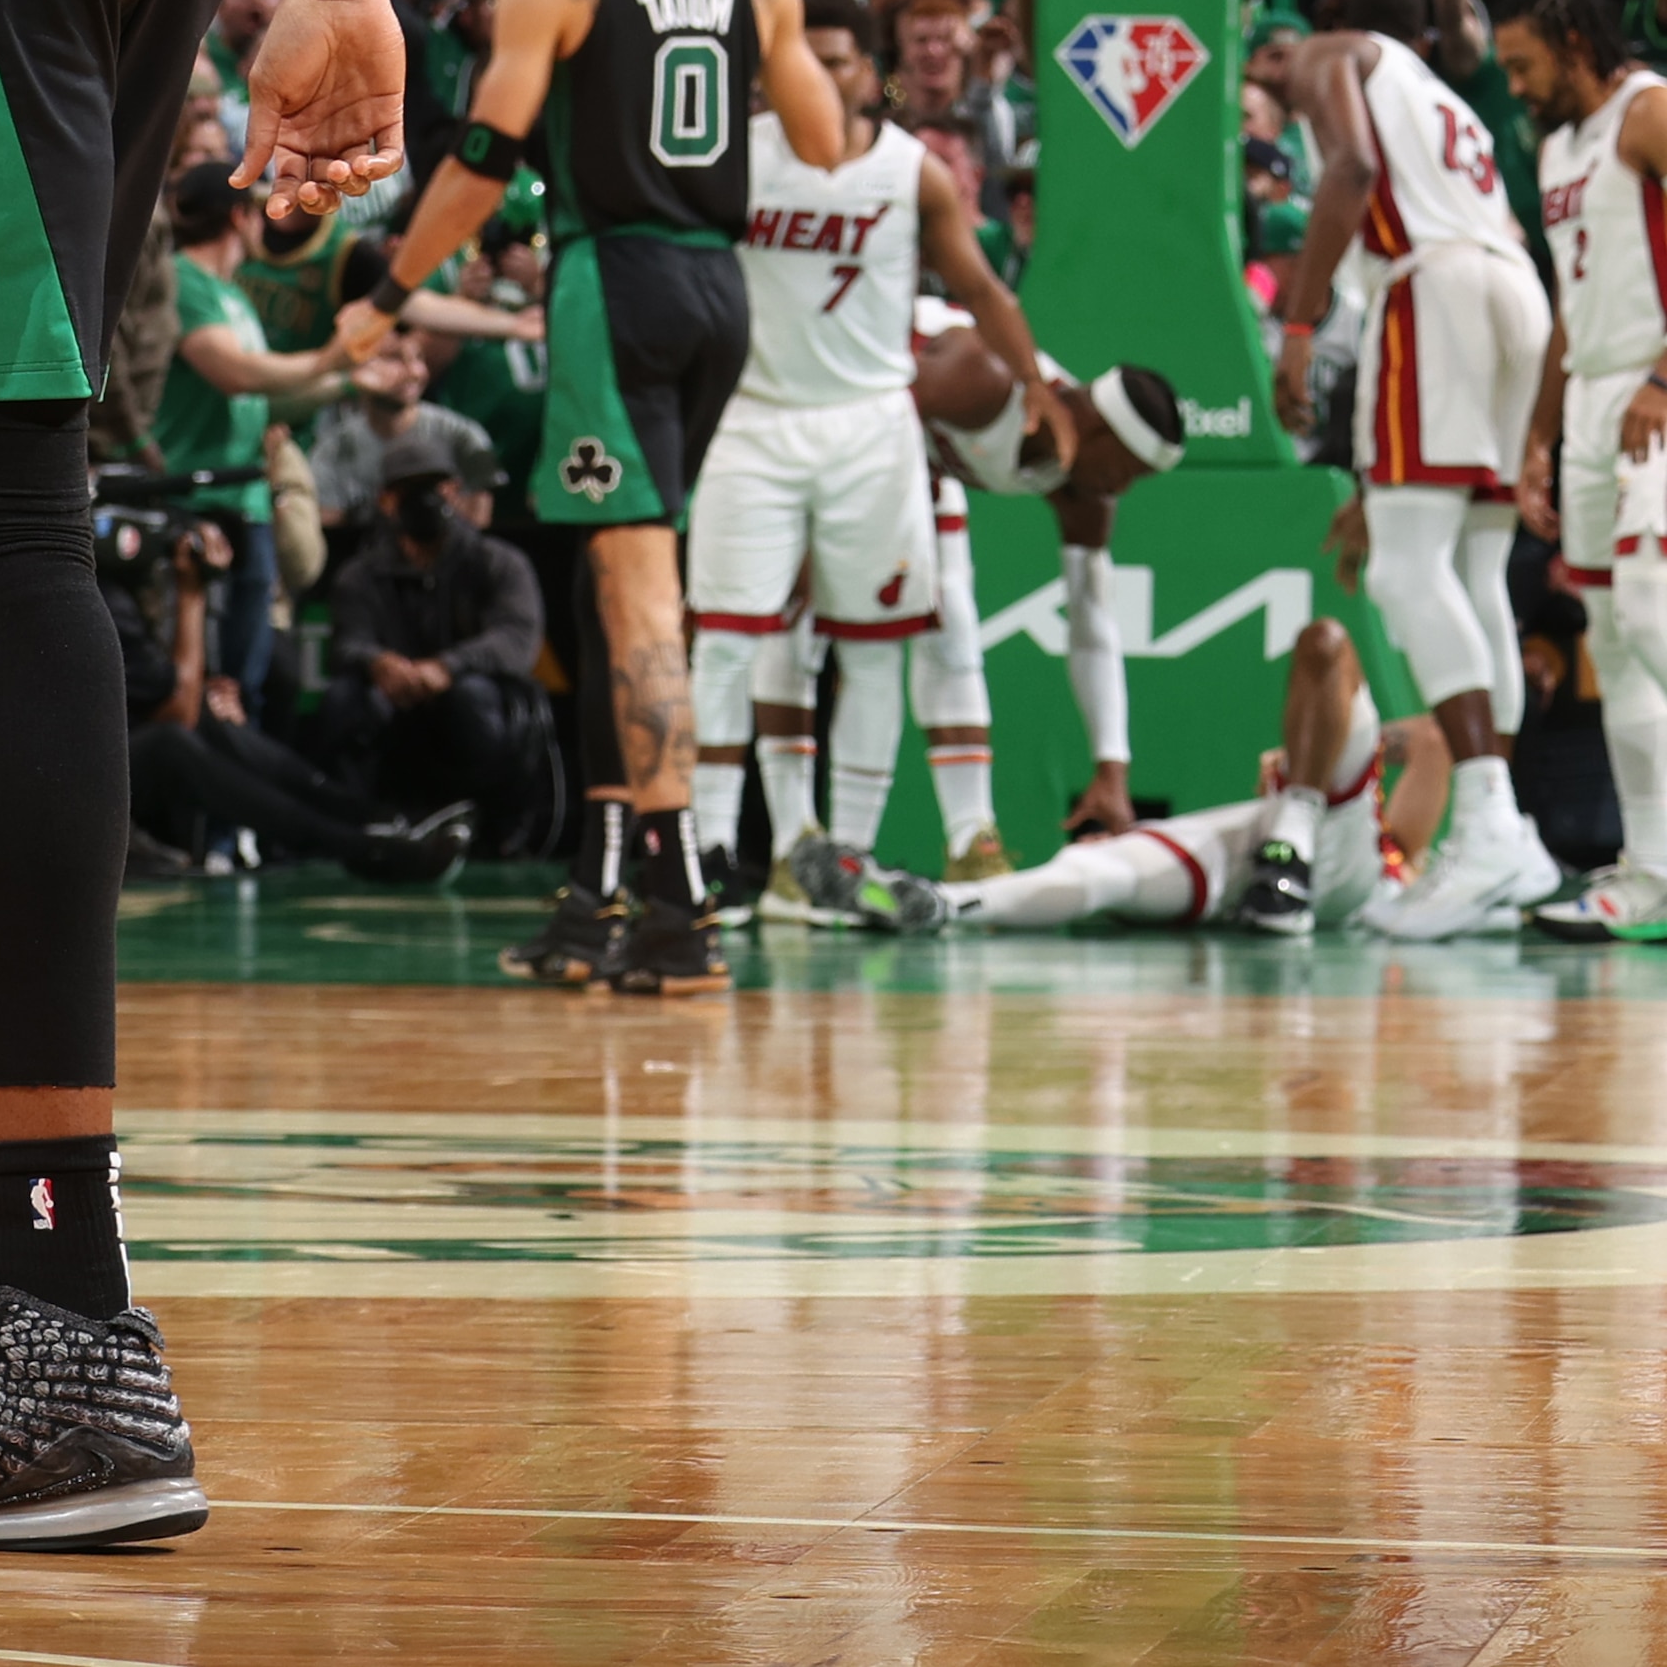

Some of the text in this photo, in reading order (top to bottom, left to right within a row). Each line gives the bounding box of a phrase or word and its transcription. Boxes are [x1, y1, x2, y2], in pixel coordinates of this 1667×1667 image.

[649, 36, 729, 168] 0
[466, 124, 493, 165] 0
[747, 202, 888, 254] HEAT
[823, 265, 863, 312] 7
[1177, 394, 1253, 439] ixel
